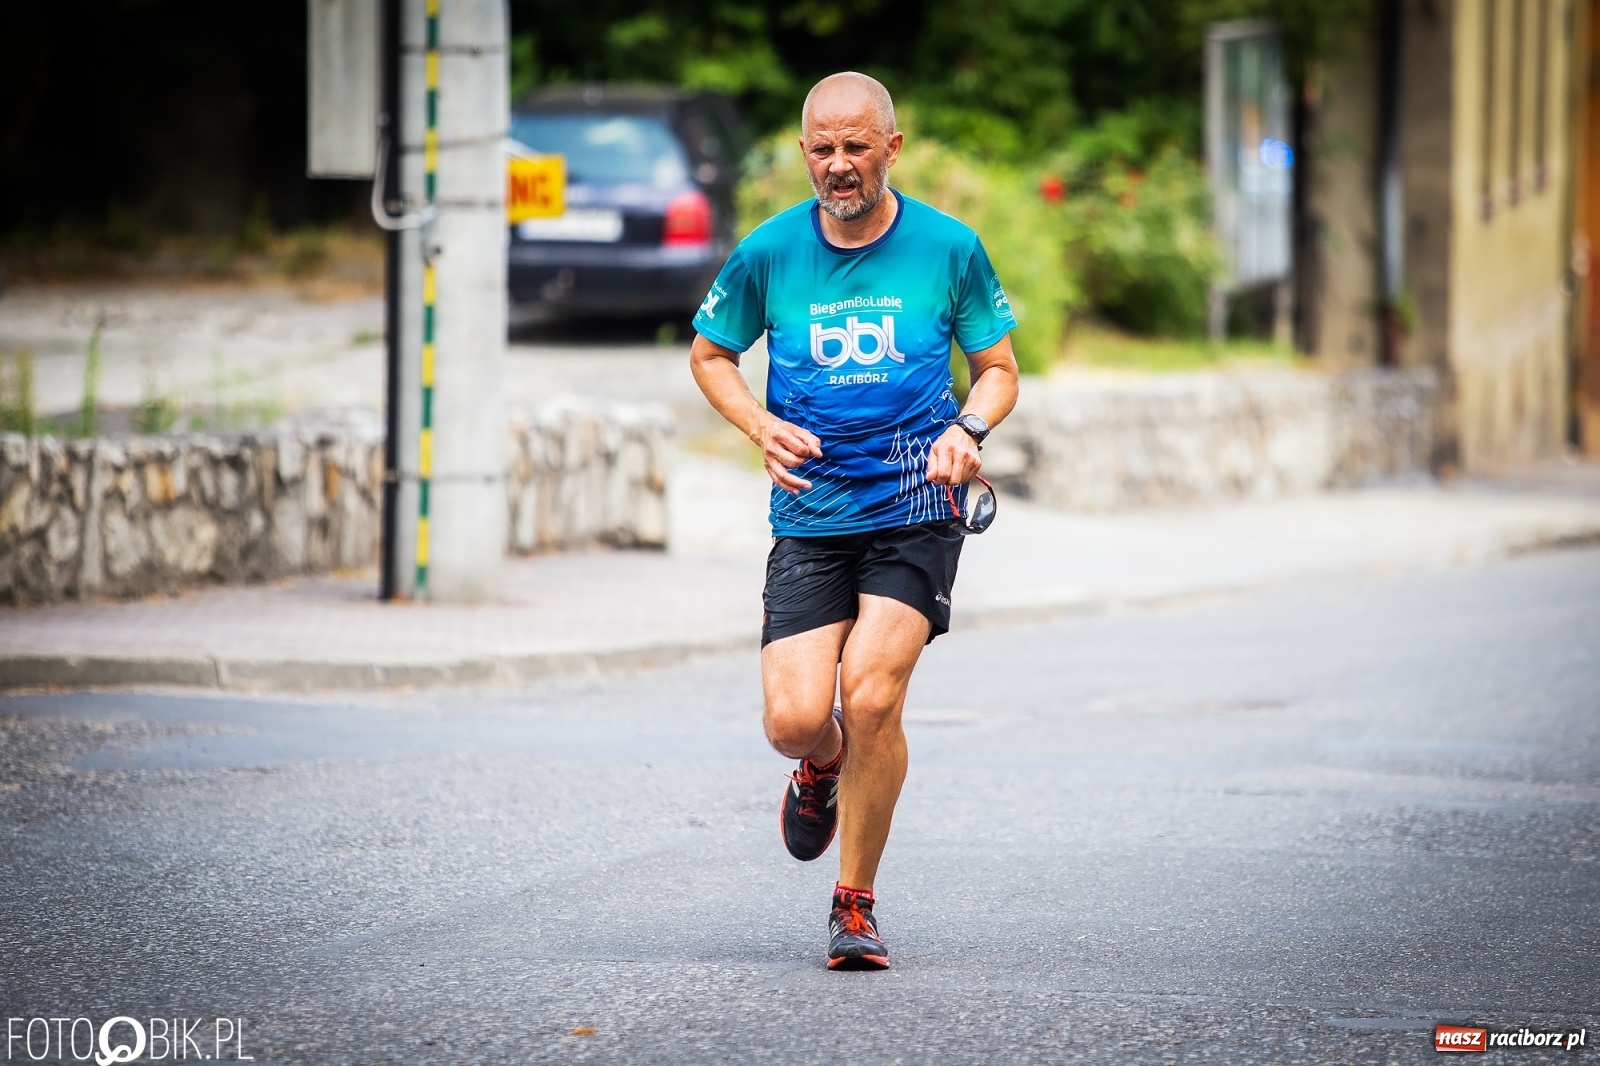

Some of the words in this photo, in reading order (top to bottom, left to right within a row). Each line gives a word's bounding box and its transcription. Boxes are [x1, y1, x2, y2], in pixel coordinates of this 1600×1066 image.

[810, 295, 903, 316] BiegamBoLubię
[809, 314, 905, 369] bbl
[829, 372, 889, 385] RACIBÓRZ
